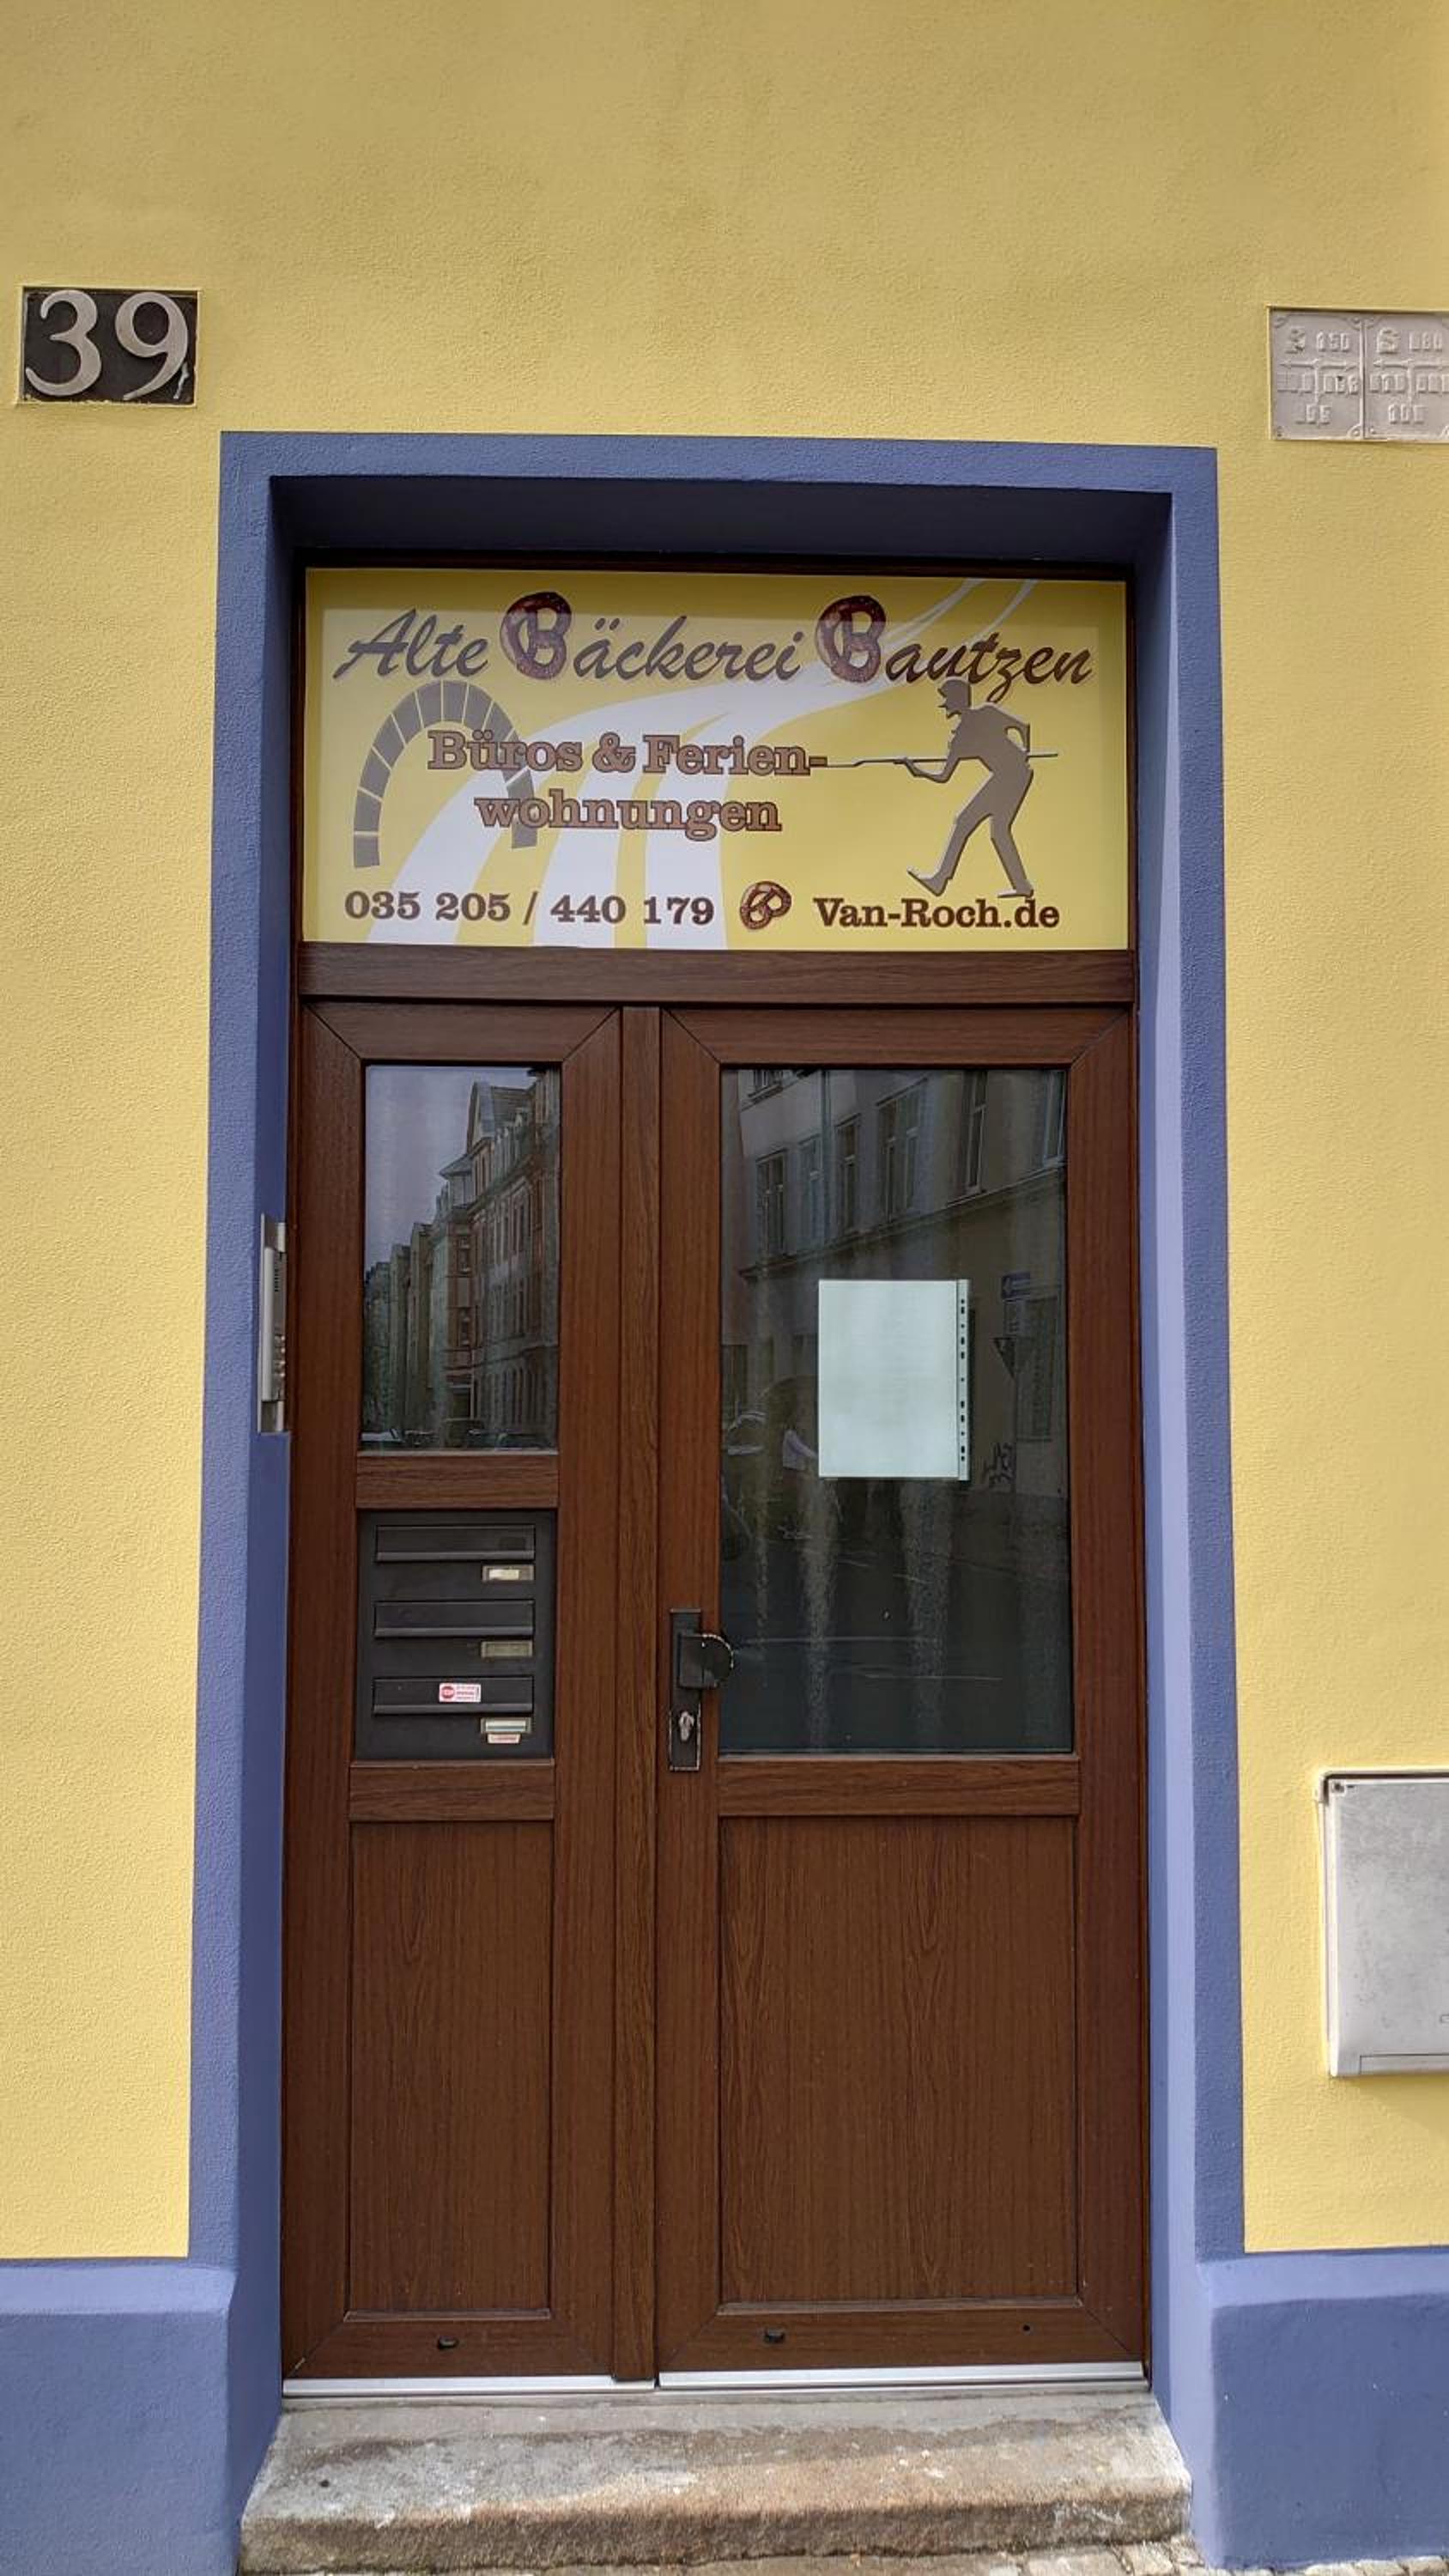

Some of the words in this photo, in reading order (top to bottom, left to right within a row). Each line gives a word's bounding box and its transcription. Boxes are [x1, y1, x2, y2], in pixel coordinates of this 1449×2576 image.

[26, 289, 188, 400] 39
[333, 608, 489, 678] Alte
[500, 591, 805, 681] Bäckerei
[815, 595, 1093, 703] Bautzen
[427, 729, 582, 771] Büros
[592, 732, 636, 773] &
[643, 734, 828, 775] Ferien-
[474, 788, 782, 841] wohnungen
[344, 890, 421, 920] 035
[435, 891, 511, 921] 205
[522, 891, 538, 925] /
[550, 895, 627, 924] 440
[643, 896, 714, 925] 179
[814, 896, 1059, 928] Van-Roch.de
